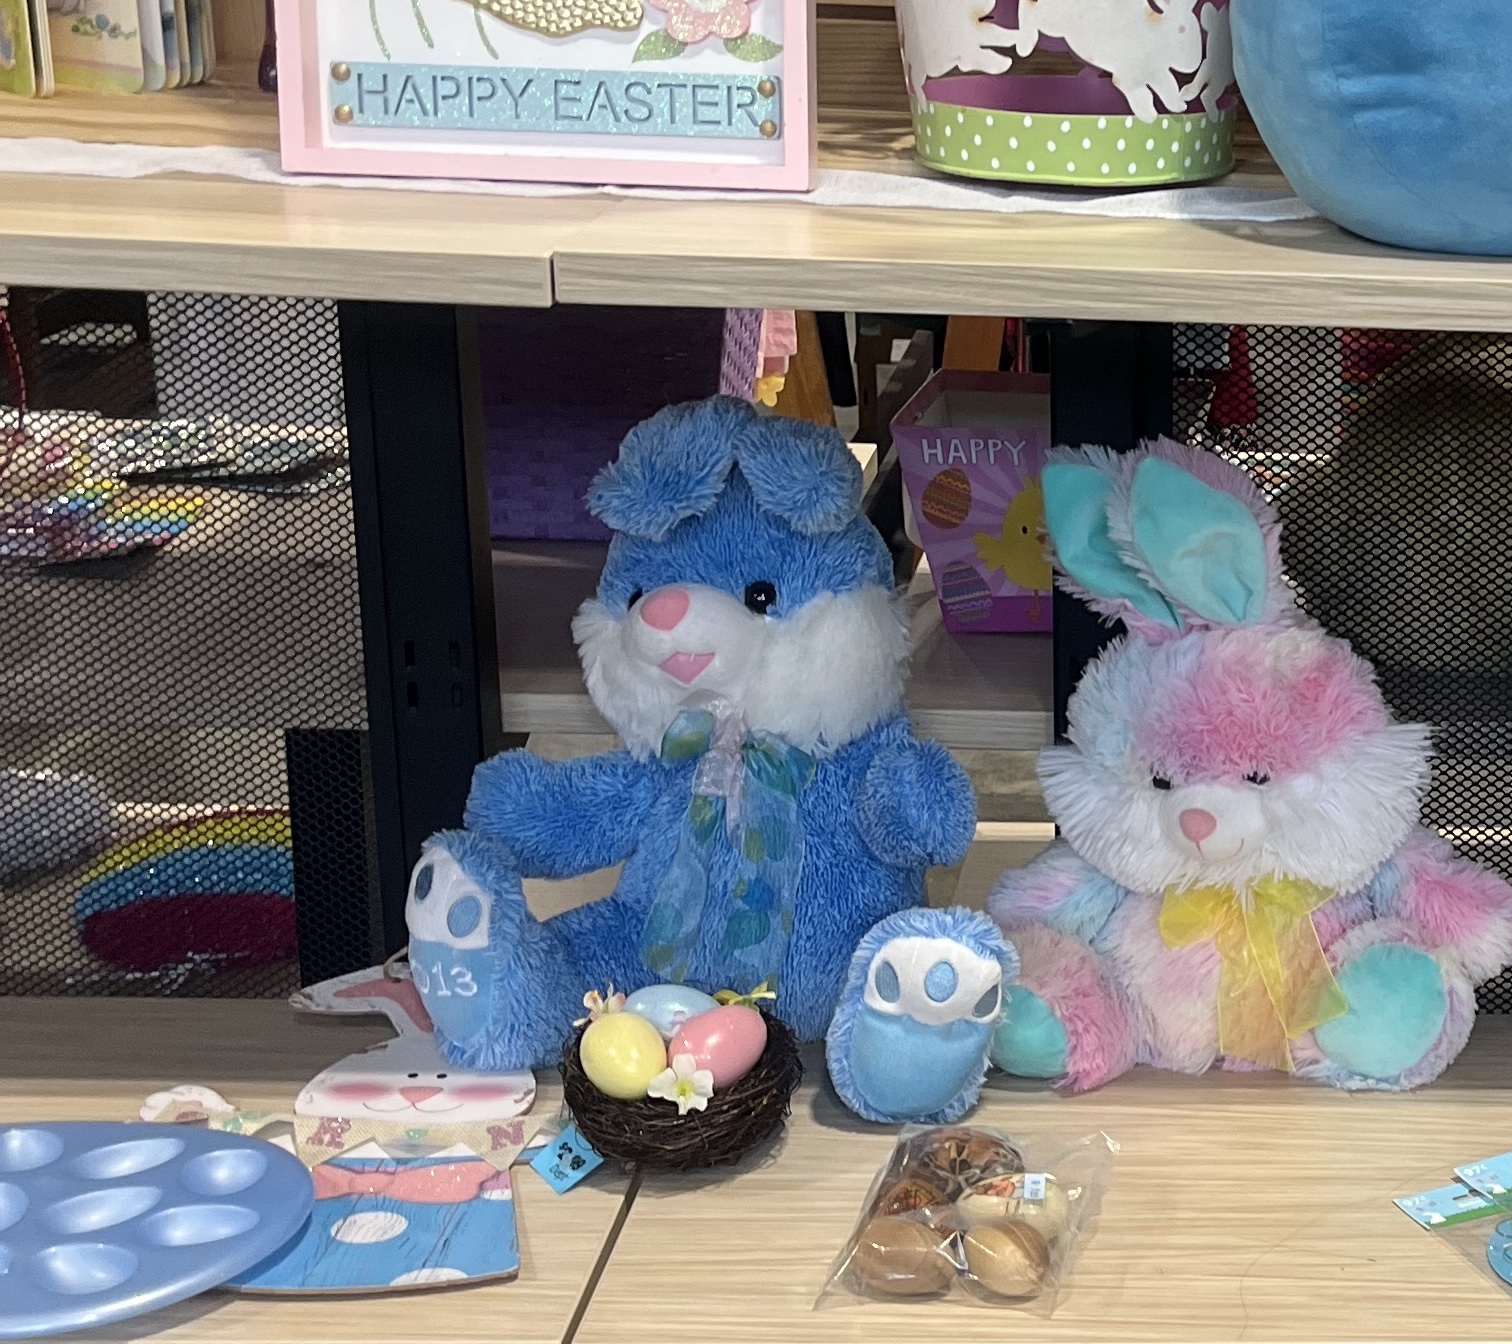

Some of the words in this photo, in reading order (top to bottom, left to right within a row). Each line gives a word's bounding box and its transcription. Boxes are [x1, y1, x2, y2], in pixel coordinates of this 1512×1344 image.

[356, 73, 535, 120] HAPPY
[553, 78, 761, 127] EASTER
[921, 438, 1026, 466] HAPPY
